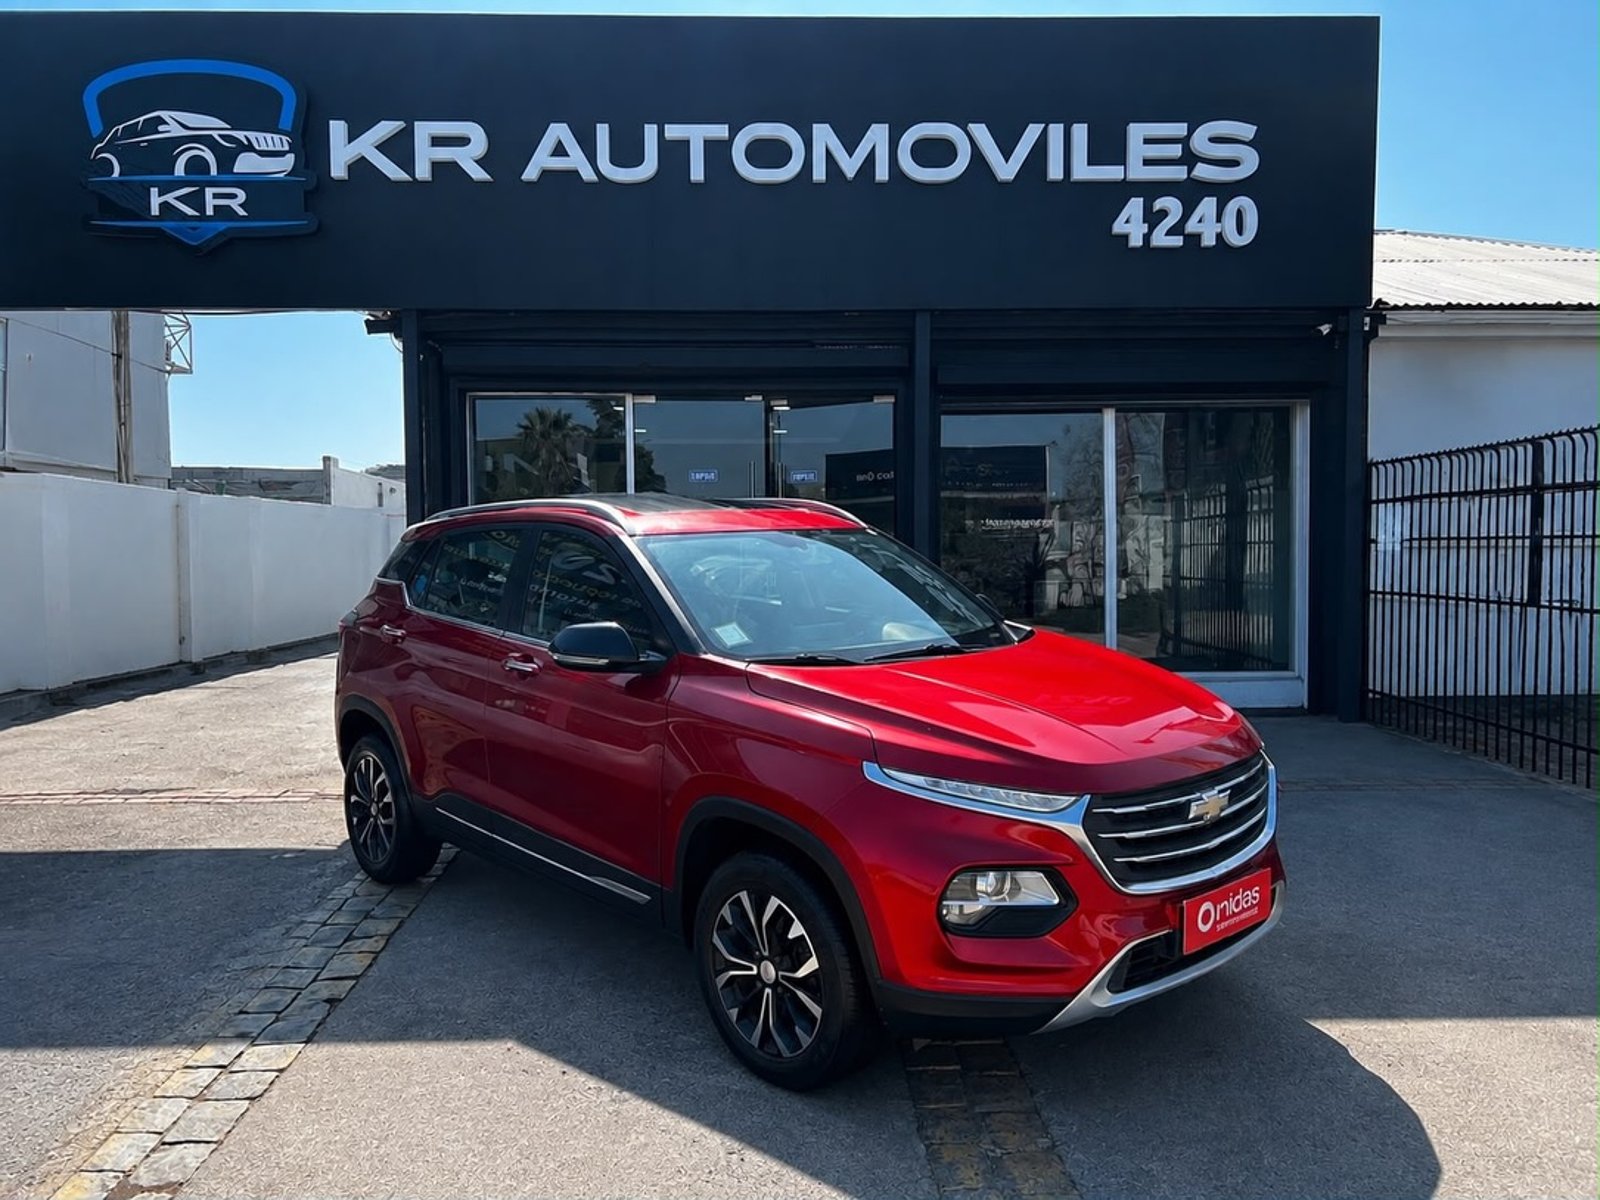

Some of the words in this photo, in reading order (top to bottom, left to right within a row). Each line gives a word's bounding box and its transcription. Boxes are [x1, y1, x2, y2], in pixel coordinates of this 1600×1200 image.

[329, 119, 492, 182] KR
[521, 120, 1259, 184] AUTOMOVILES
[149, 186, 249, 216] KR
[1111, 195, 1258, 248] 4240
